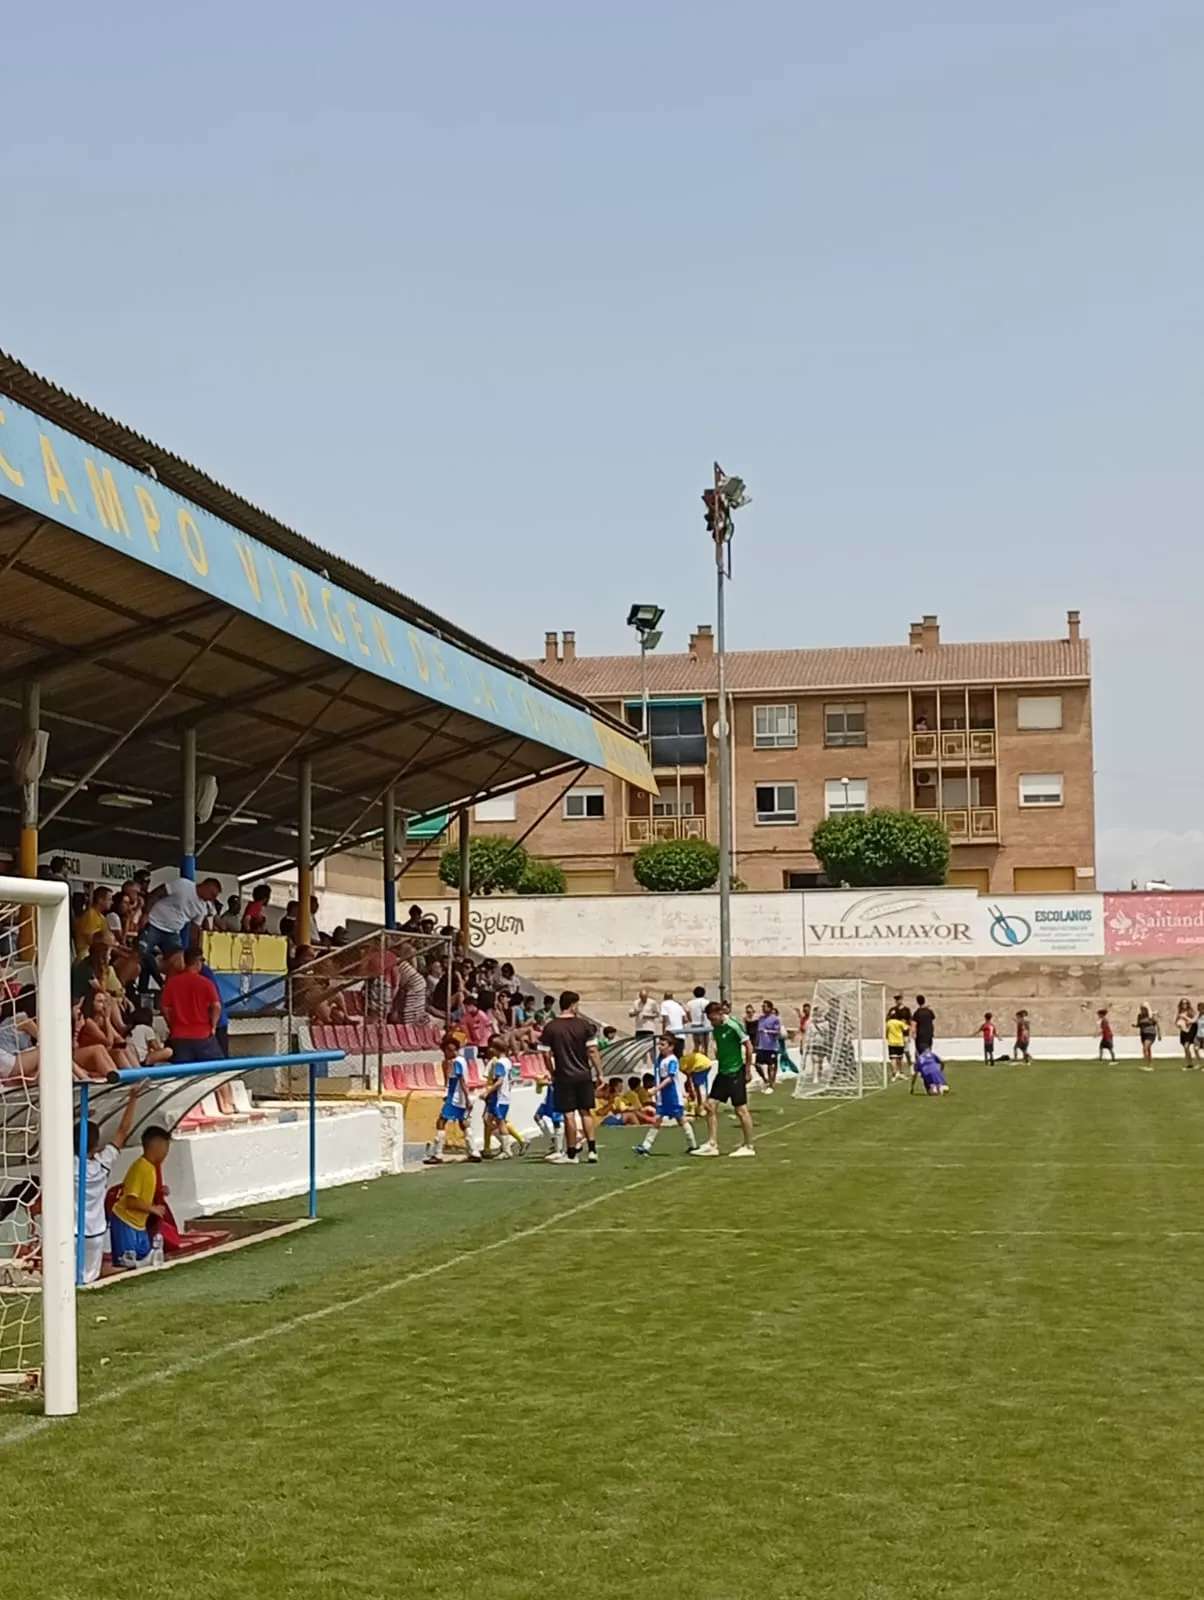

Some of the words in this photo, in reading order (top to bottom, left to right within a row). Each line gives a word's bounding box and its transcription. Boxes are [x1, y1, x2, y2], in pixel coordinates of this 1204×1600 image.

[0, 409, 208, 577] CAMPO
[235, 538, 395, 667] VIRGEN
[408, 630, 452, 694] DE
[1035, 909, 1092, 922] ESCOLANOS
[808, 923, 972, 941] VILLAMAYOR
